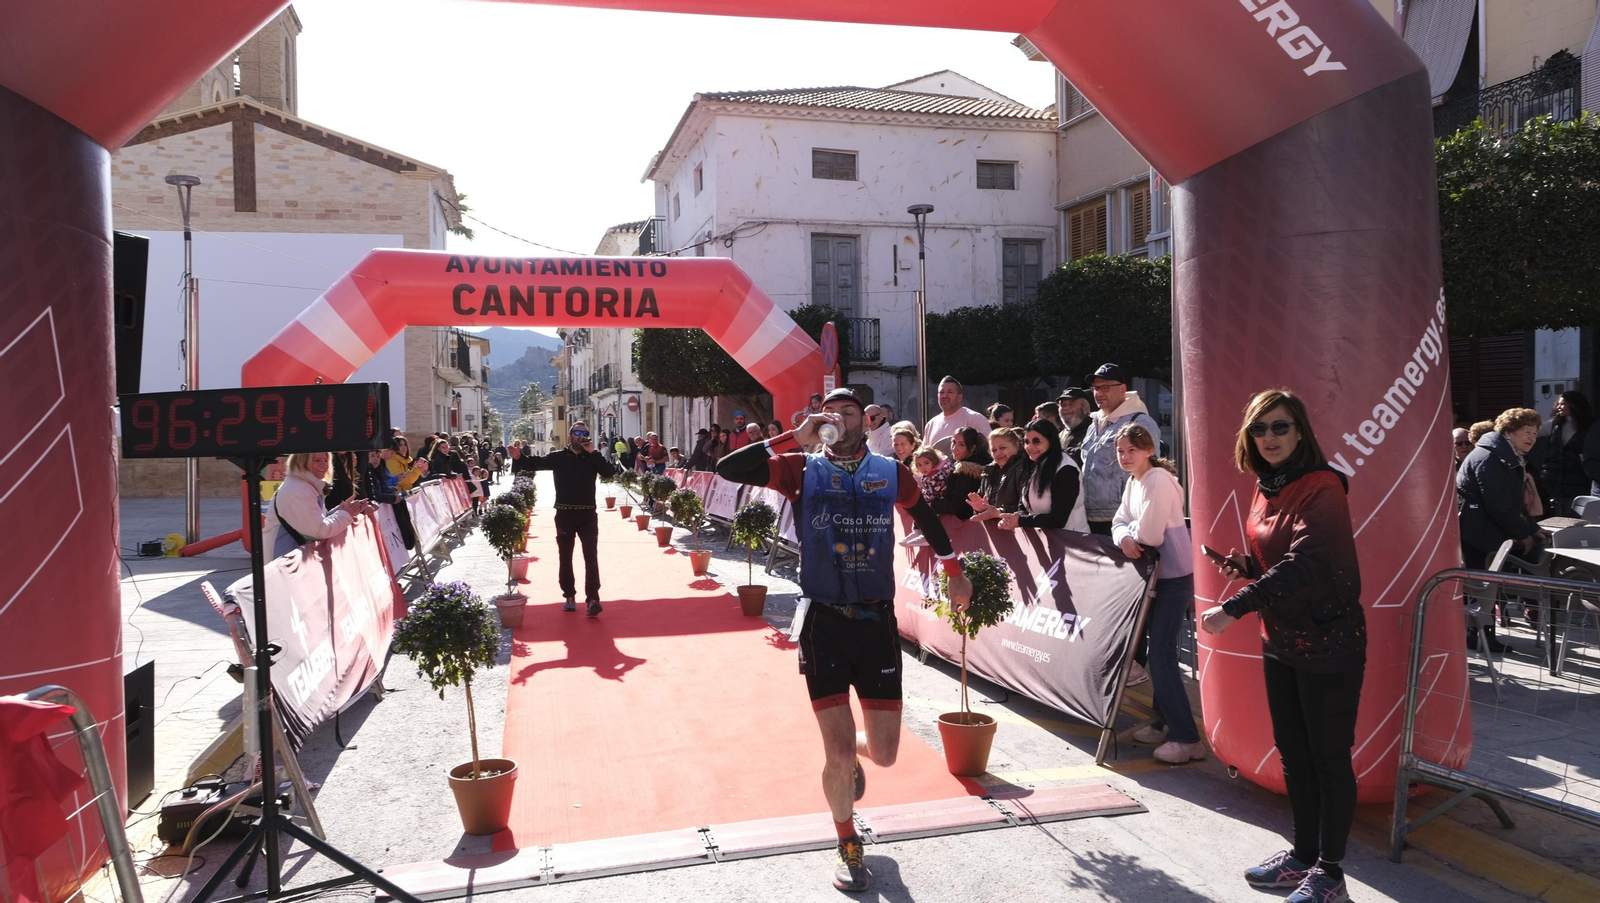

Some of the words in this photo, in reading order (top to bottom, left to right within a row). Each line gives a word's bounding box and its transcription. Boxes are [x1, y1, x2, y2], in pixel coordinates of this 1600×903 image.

[445, 254, 668, 278] AYUNTAMIENTO
[452, 283, 660, 318] CANTORIA
[832, 513, 863, 526] Casa
[1001, 637, 1051, 664] www.teamergy.es
